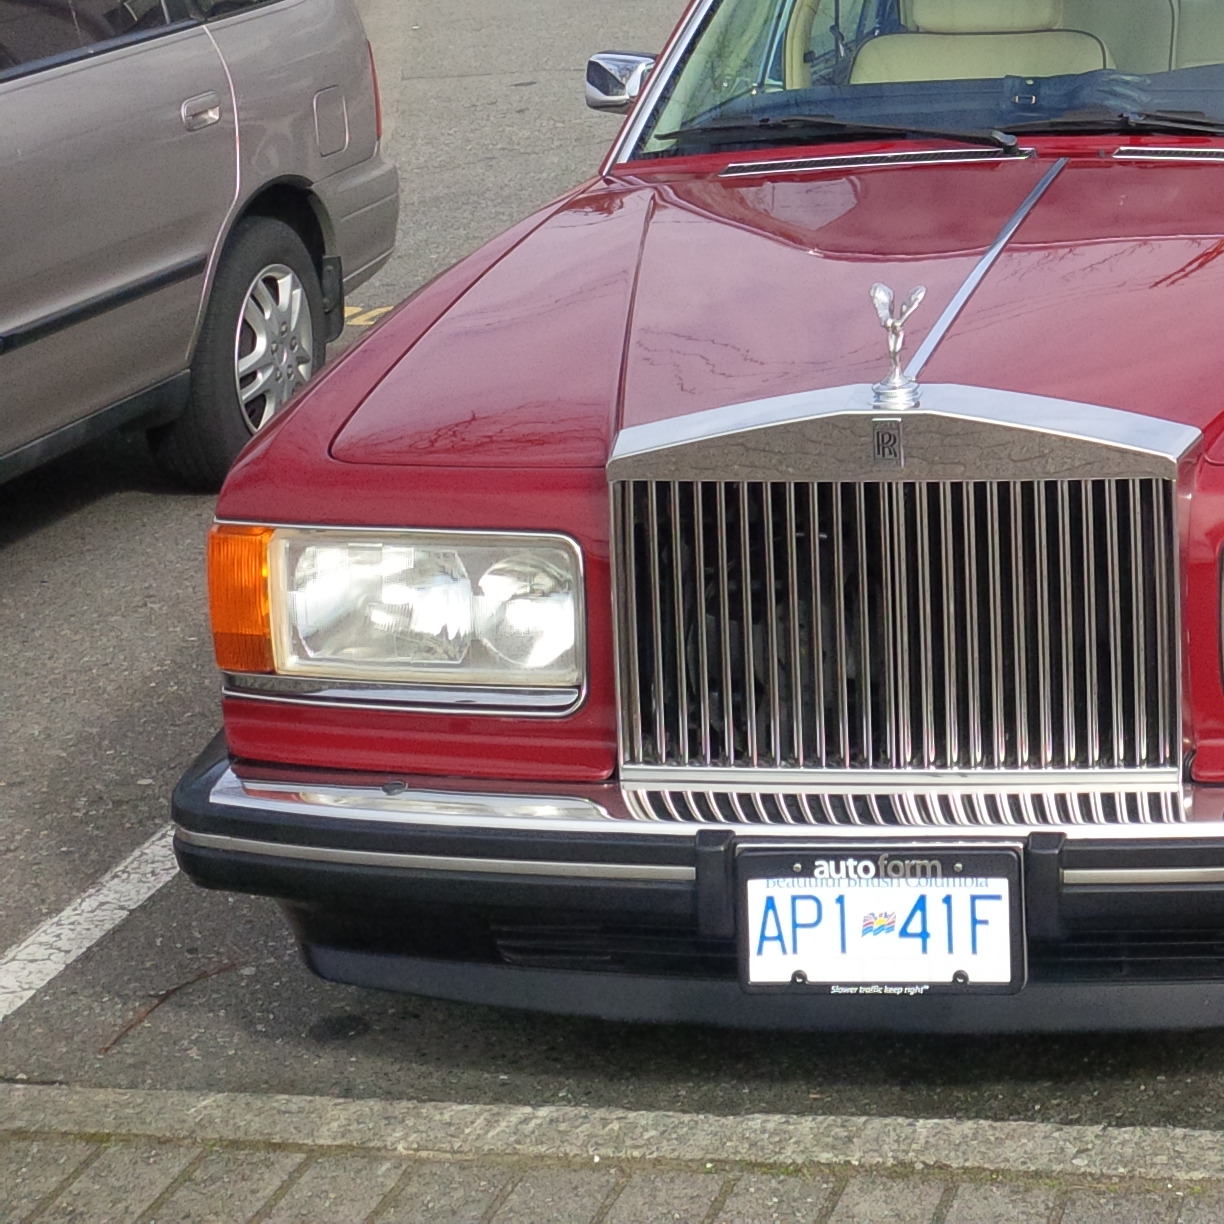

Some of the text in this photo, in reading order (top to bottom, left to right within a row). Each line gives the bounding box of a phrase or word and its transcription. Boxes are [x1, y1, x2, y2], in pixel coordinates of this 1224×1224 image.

[756, 893, 1003, 956] AP1 41F
[831, 984, 858, 994] Slower
[859, 984, 883, 994] traffic
[884, 985, 903, 995] keep
